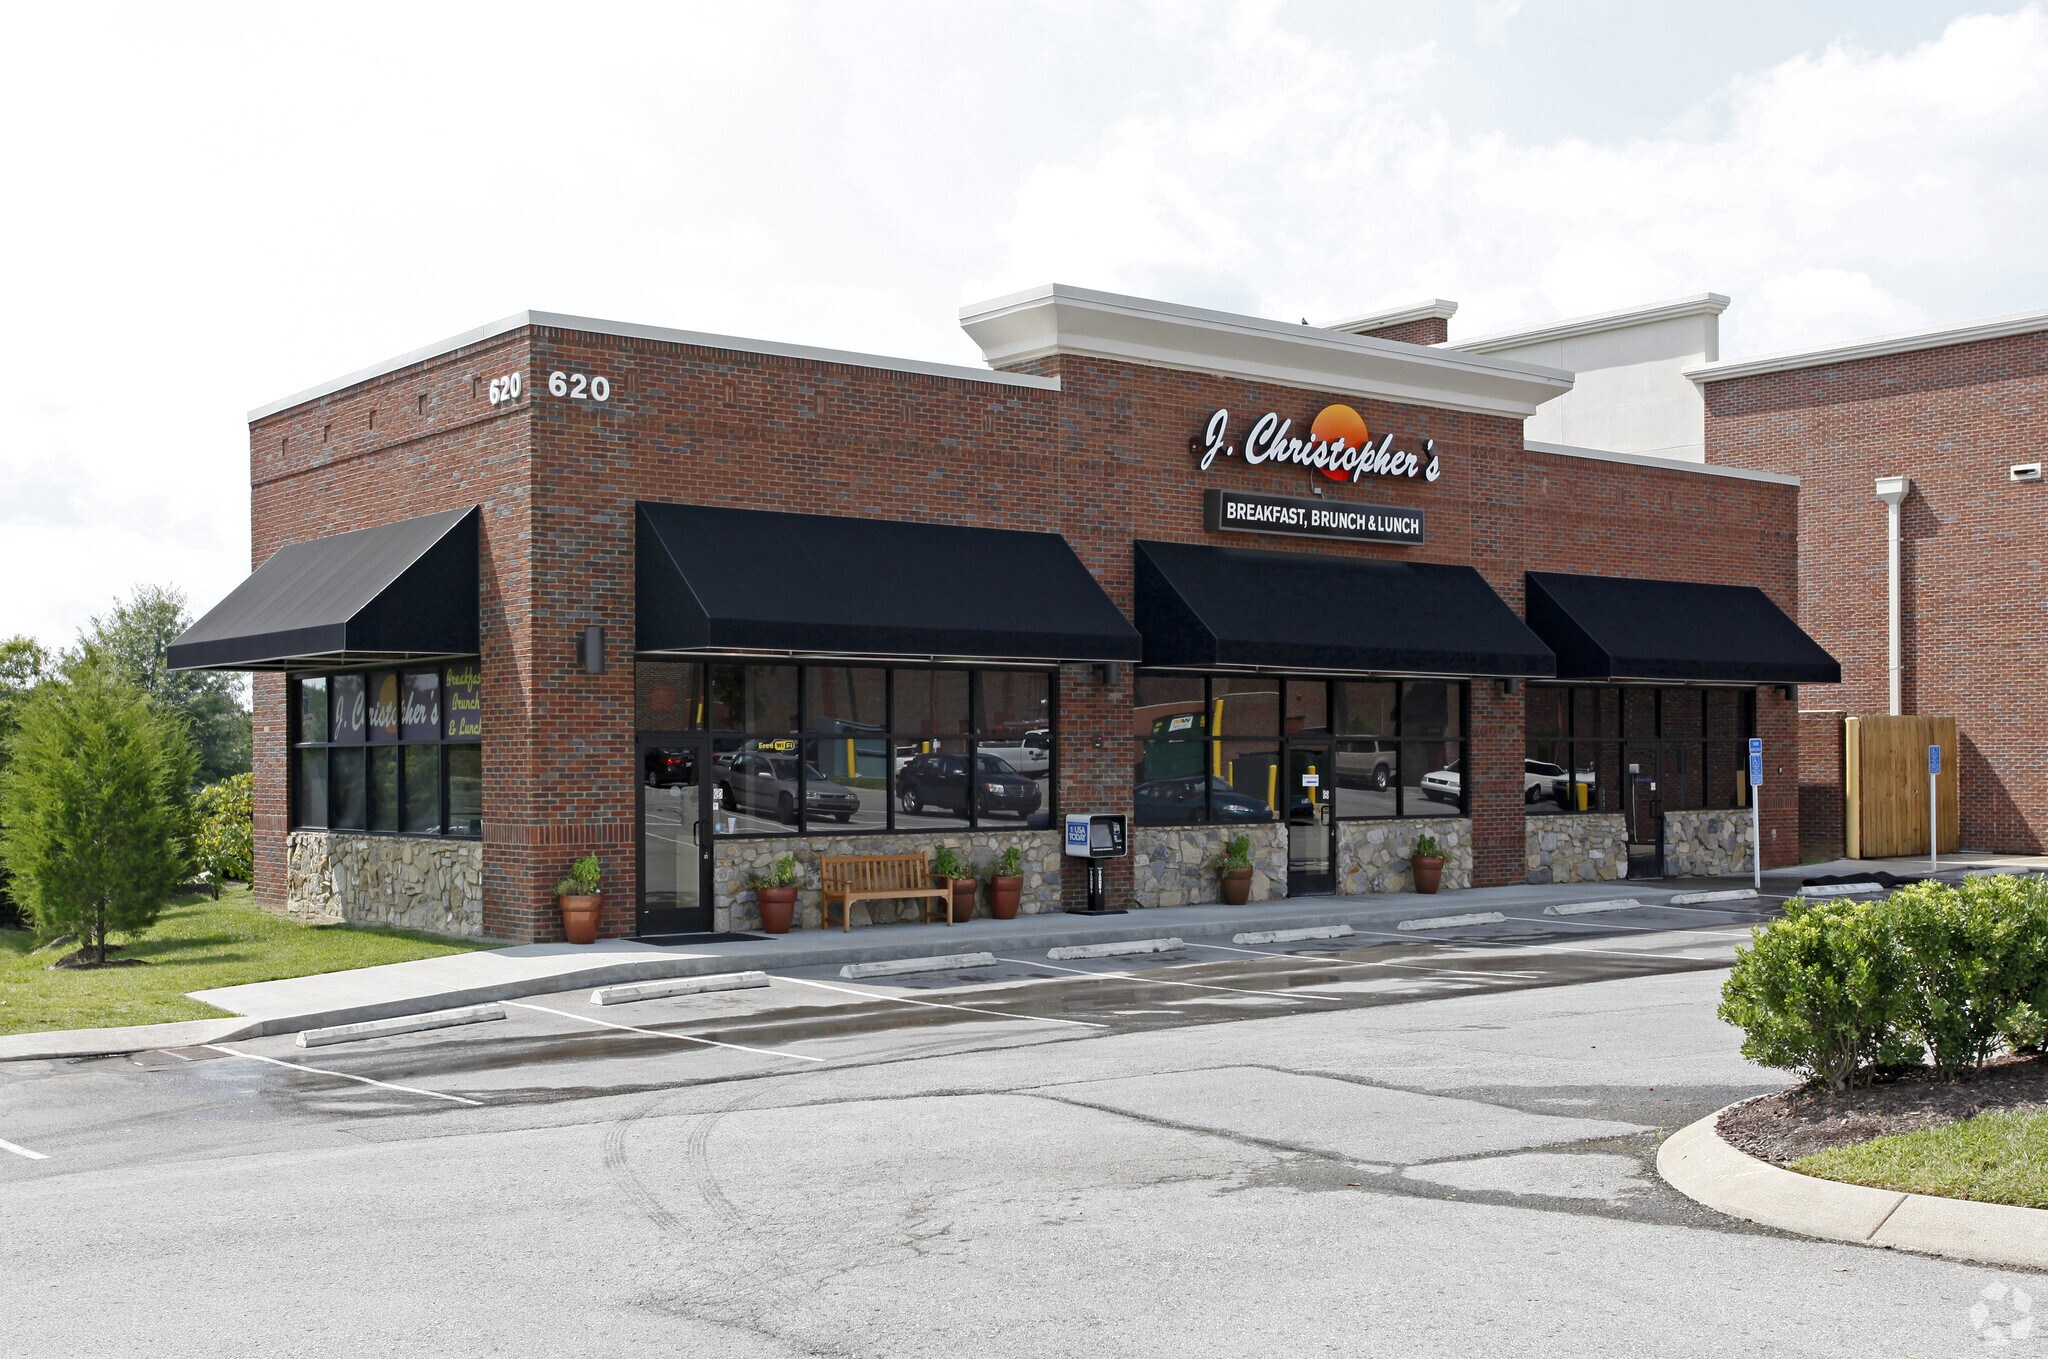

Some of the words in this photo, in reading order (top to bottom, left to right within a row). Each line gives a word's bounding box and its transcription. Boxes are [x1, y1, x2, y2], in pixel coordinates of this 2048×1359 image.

[489, 372, 522, 405] 620
[548, 371, 610, 402] 620
[1200, 408, 1234, 470] J.
[1245, 411, 1441, 483] Christopher's
[1227, 502, 1308, 528] BREAKFAST,
[1311, 509, 1366, 531] BRUNCH
[1368, 517, 1377, 531] &
[1377, 518, 1419, 534] LUNCH
[452, 691, 480, 710] Brunch
[334, 695, 347, 740] J.
[448, 719, 456, 735] &
[1069, 833, 1087, 841] TODAY
[1074, 826, 1086, 834] USA
